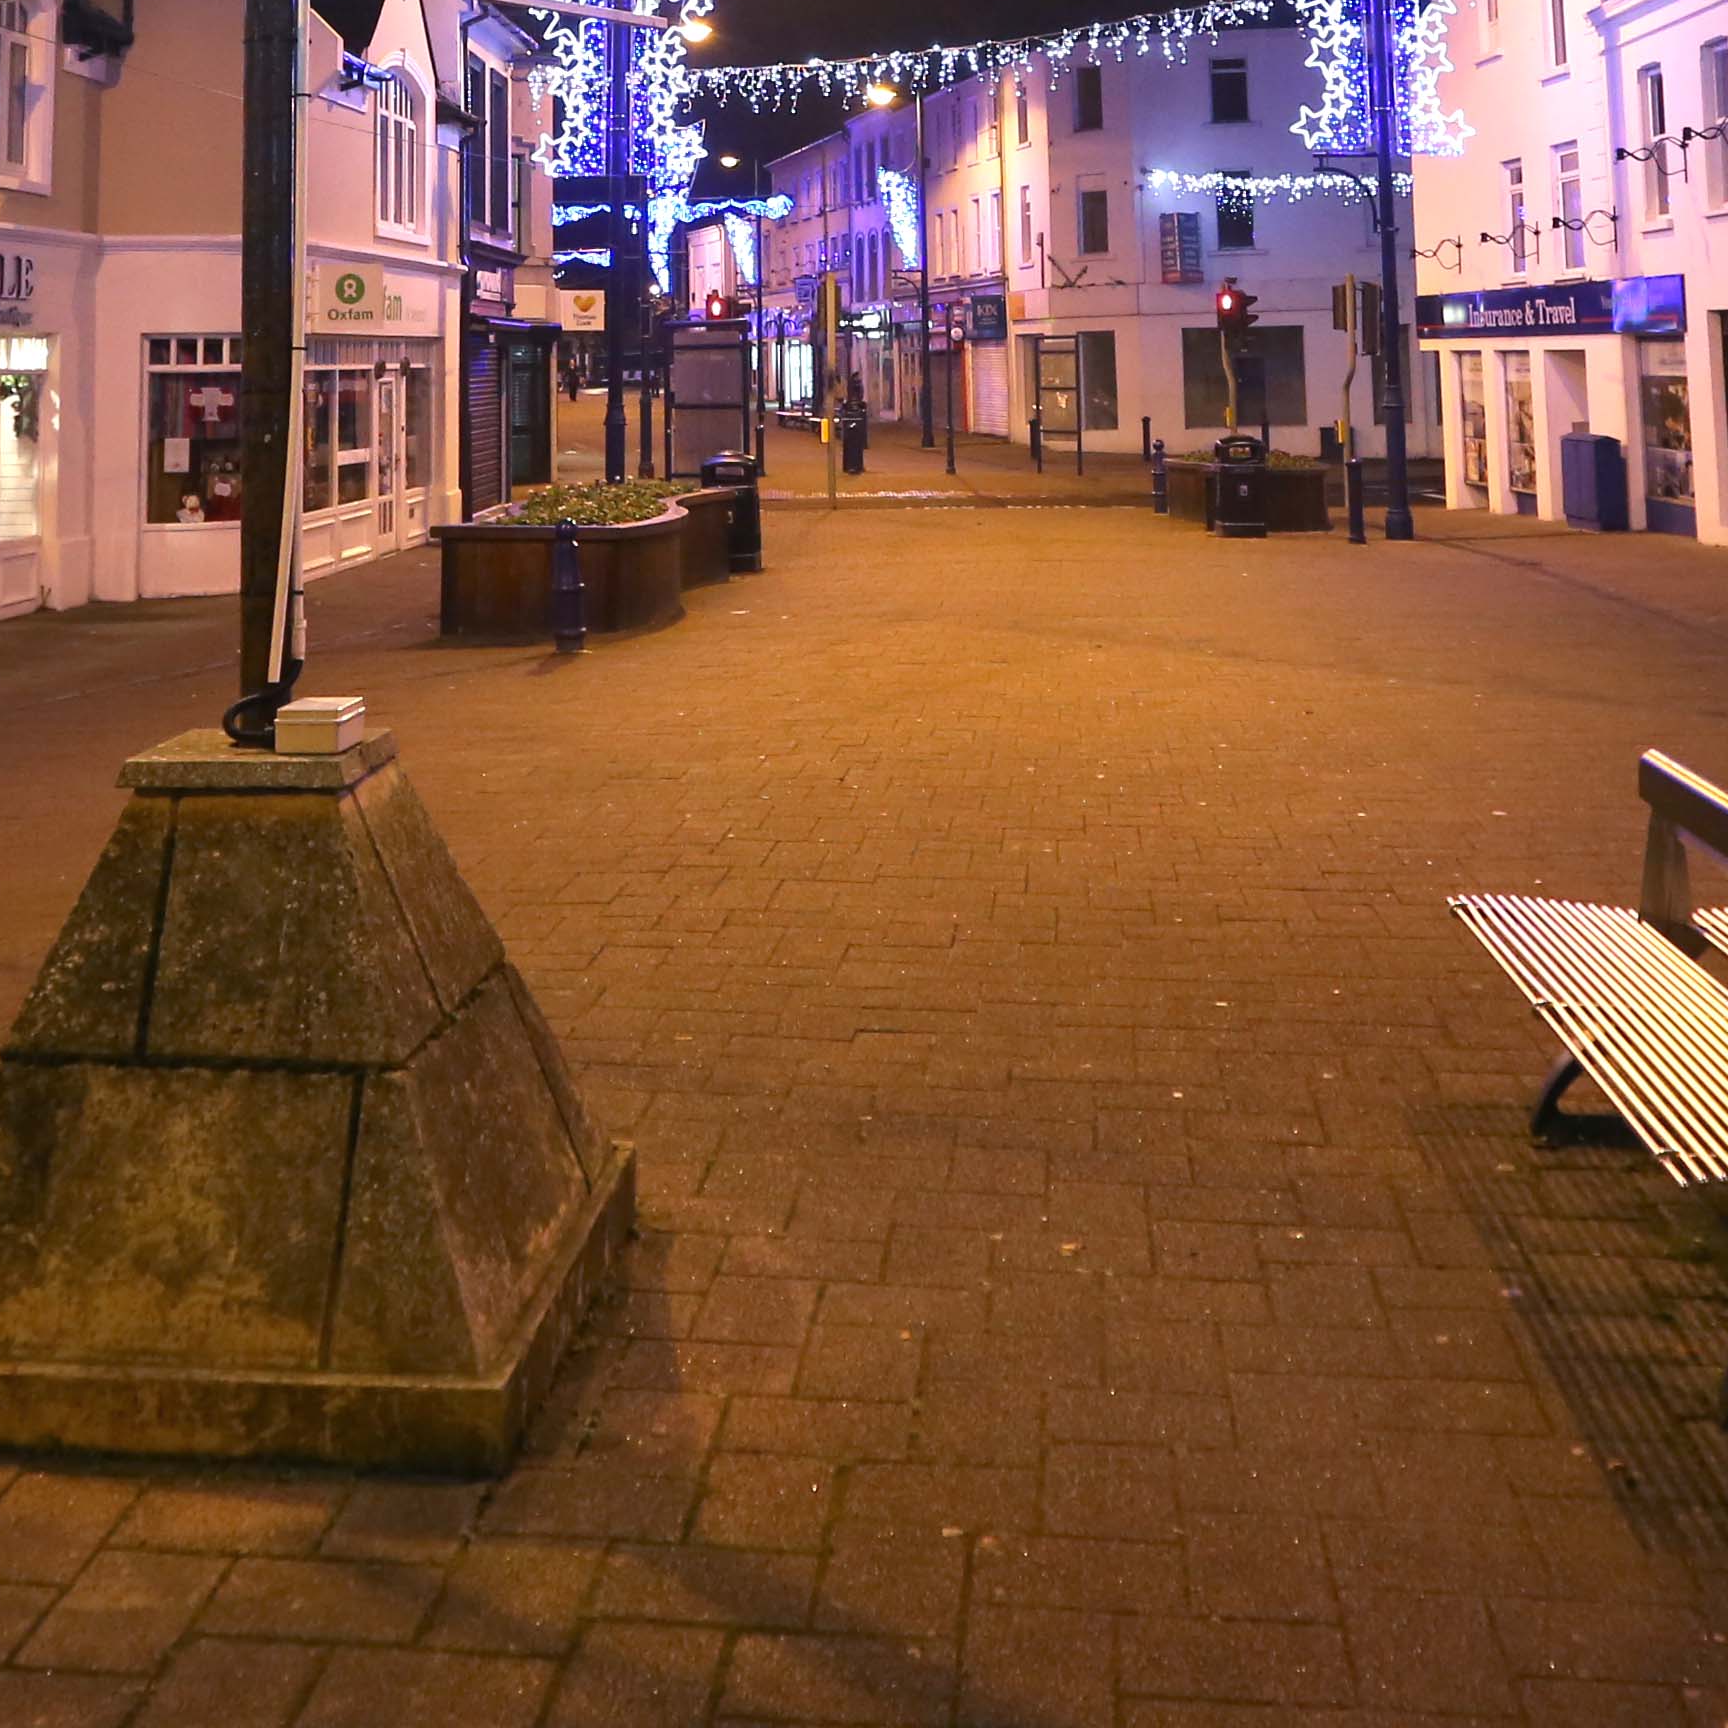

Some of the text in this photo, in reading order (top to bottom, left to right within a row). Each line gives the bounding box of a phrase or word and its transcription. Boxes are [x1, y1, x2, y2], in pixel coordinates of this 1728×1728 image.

[327, 308, 373, 321] Oxfam
[1468, 303, 1523, 329] Insurance
[1524, 300, 1534, 326] &
[1535, 297, 1576, 325] Travel
